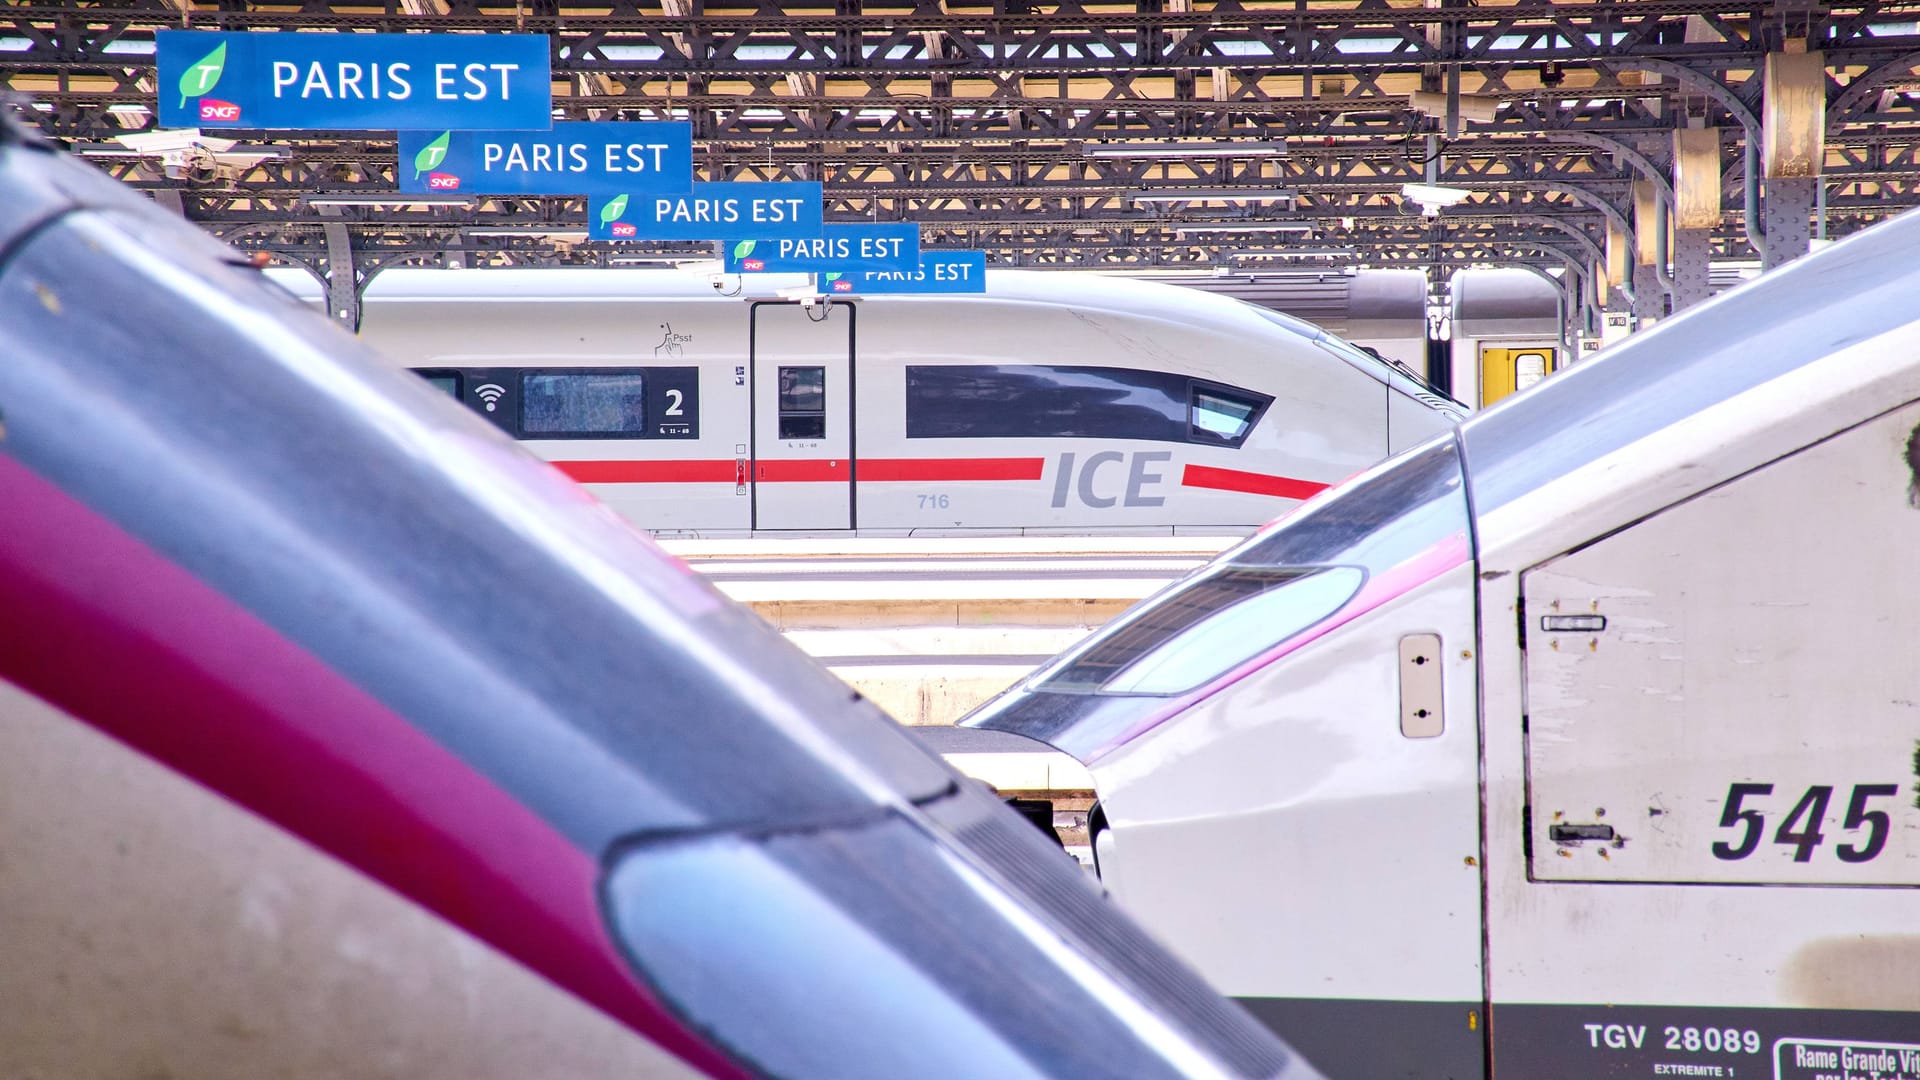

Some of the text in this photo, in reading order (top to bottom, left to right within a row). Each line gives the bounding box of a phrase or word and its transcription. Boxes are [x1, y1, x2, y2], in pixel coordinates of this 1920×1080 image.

[273, 61, 518, 100] PARIS EST
[201, 106, 239, 119] SNCF
[484, 143, 669, 173] PARIS EST
[430, 178, 458, 187] SNCF
[655, 199, 804, 222] PARIS EST
[612, 226, 635, 235] SNCF
[780, 238, 904, 258] PARIS EST
[744, 262, 764, 270] SNCF
[935, 264, 973, 281] EST
[673, 333, 692, 342] Psst
[665, 389, 683, 416] 2
[1050, 450, 1172, 509] ICE
[917, 494, 949, 510] 716
[1711, 783, 1899, 863] 545
[1584, 1024, 1760, 1054] TGV 28089
[1796, 1044, 1838, 1069] Rame
[1842, 1046, 1897, 1072] Grande
[1654, 1063, 1735, 1078] EXTREMITE 1
